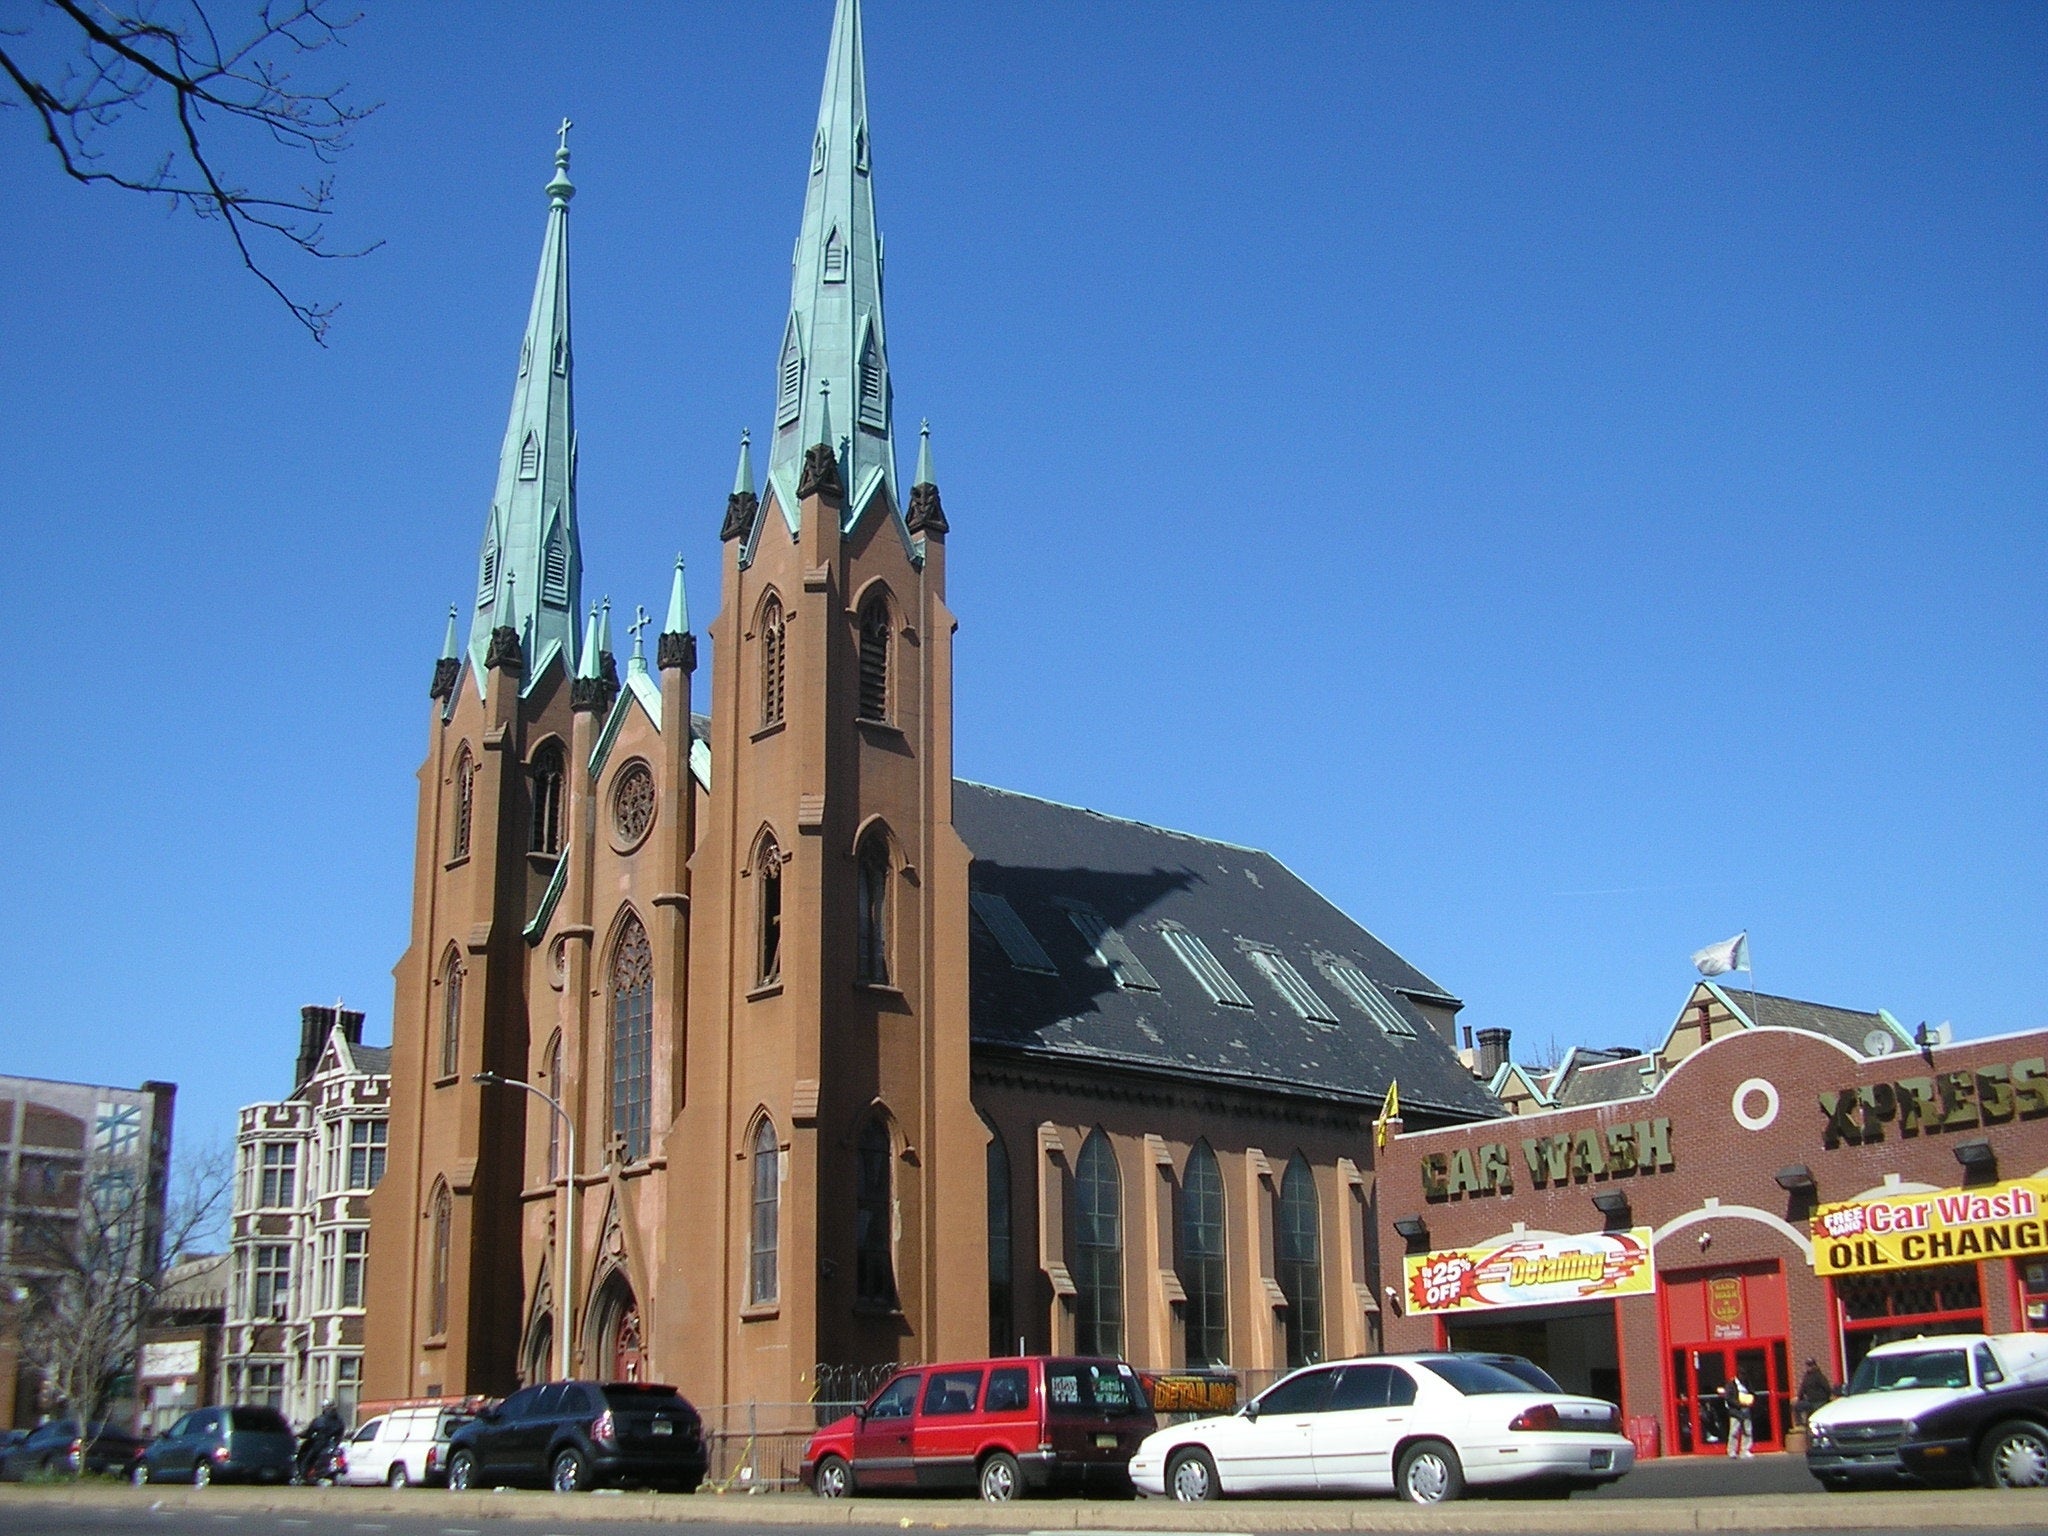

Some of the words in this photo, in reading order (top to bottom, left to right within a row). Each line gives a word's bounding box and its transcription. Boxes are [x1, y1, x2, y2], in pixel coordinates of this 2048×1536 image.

[1818, 1057, 2048, 1150] XPRESS
[1422, 1143, 1513, 1203] CAR
[1522, 1117, 1675, 1190] WASH
[1824, 1206, 1863, 1229] FREE
[1867, 1203, 1929, 1233] Car
[1937, 1187, 2033, 1226] Wash
[1829, 1239, 1888, 1269] OIL
[1902, 1219, 2048, 1261] CHANG
[1432, 1258, 1471, 1286] 25%
[1509, 1249, 1606, 1287] Detailing
[1426, 1281, 1461, 1304] OFF
[1155, 1381, 1236, 1411] DETAILING
